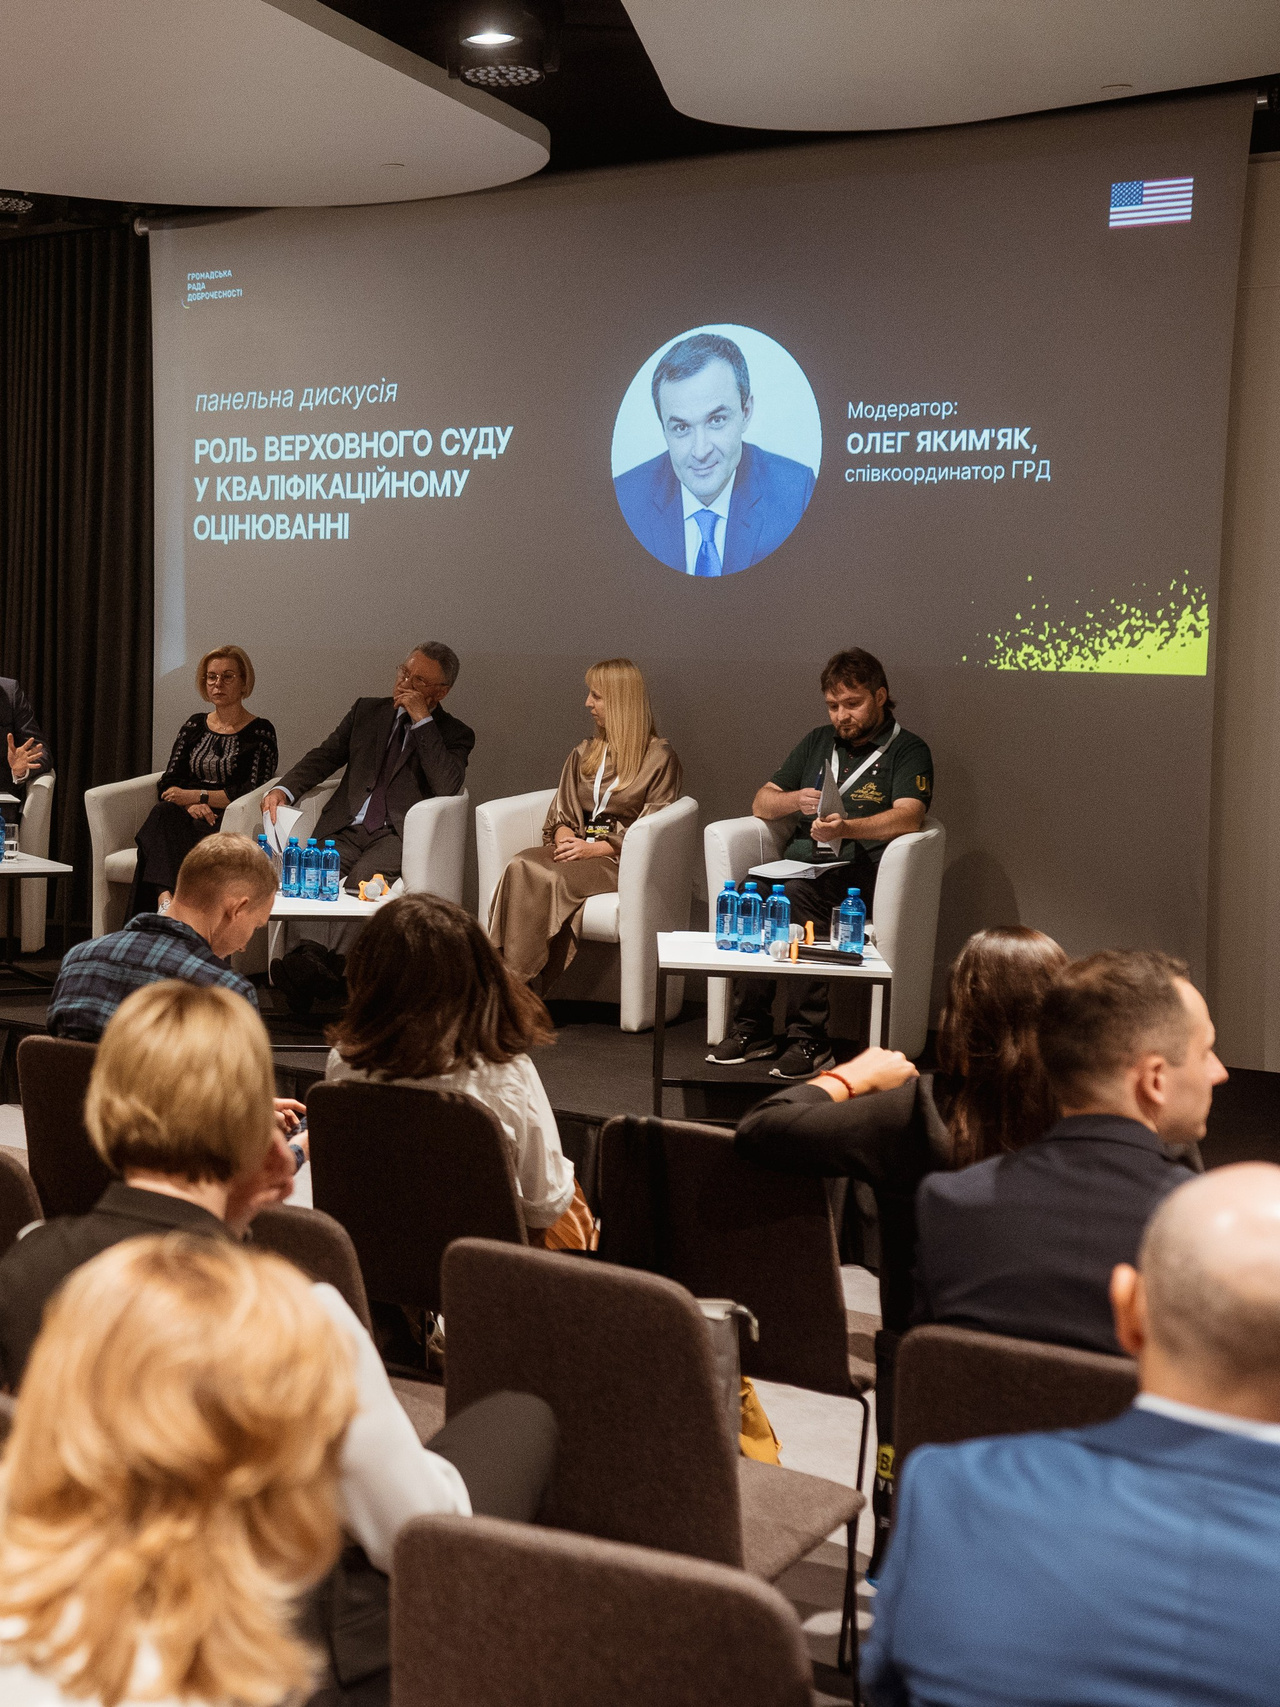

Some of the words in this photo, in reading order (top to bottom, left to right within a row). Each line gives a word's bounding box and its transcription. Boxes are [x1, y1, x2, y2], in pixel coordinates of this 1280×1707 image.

[187, 269, 232, 281] ГРОМАДСЬКА
[187, 282, 206, 291] РАДА
[187, 288, 243, 302] ДОБРОЧЕСНОСТІ
[195, 388, 294, 412] панельна
[299, 377, 398, 411] дискусія
[847, 401, 958, 421] Модератор:
[194, 438, 258, 464] РОЛЬ
[264, 429, 433, 462] ВЕРХОВНОГО
[440, 426, 514, 460] СУДУ
[846, 431, 910, 454] ОЛЕГ
[916, 427, 1037, 454] ЯКИМ'ЯК,
[194, 477, 210, 502] У
[216, 465, 470, 504] КВАЛІФІКАЦІЙНОМУ
[844, 463, 1005, 485] співкоординатор
[1011, 459, 1051, 482] ГРД
[193, 512, 350, 545] ОЦІНЮВАННІ
